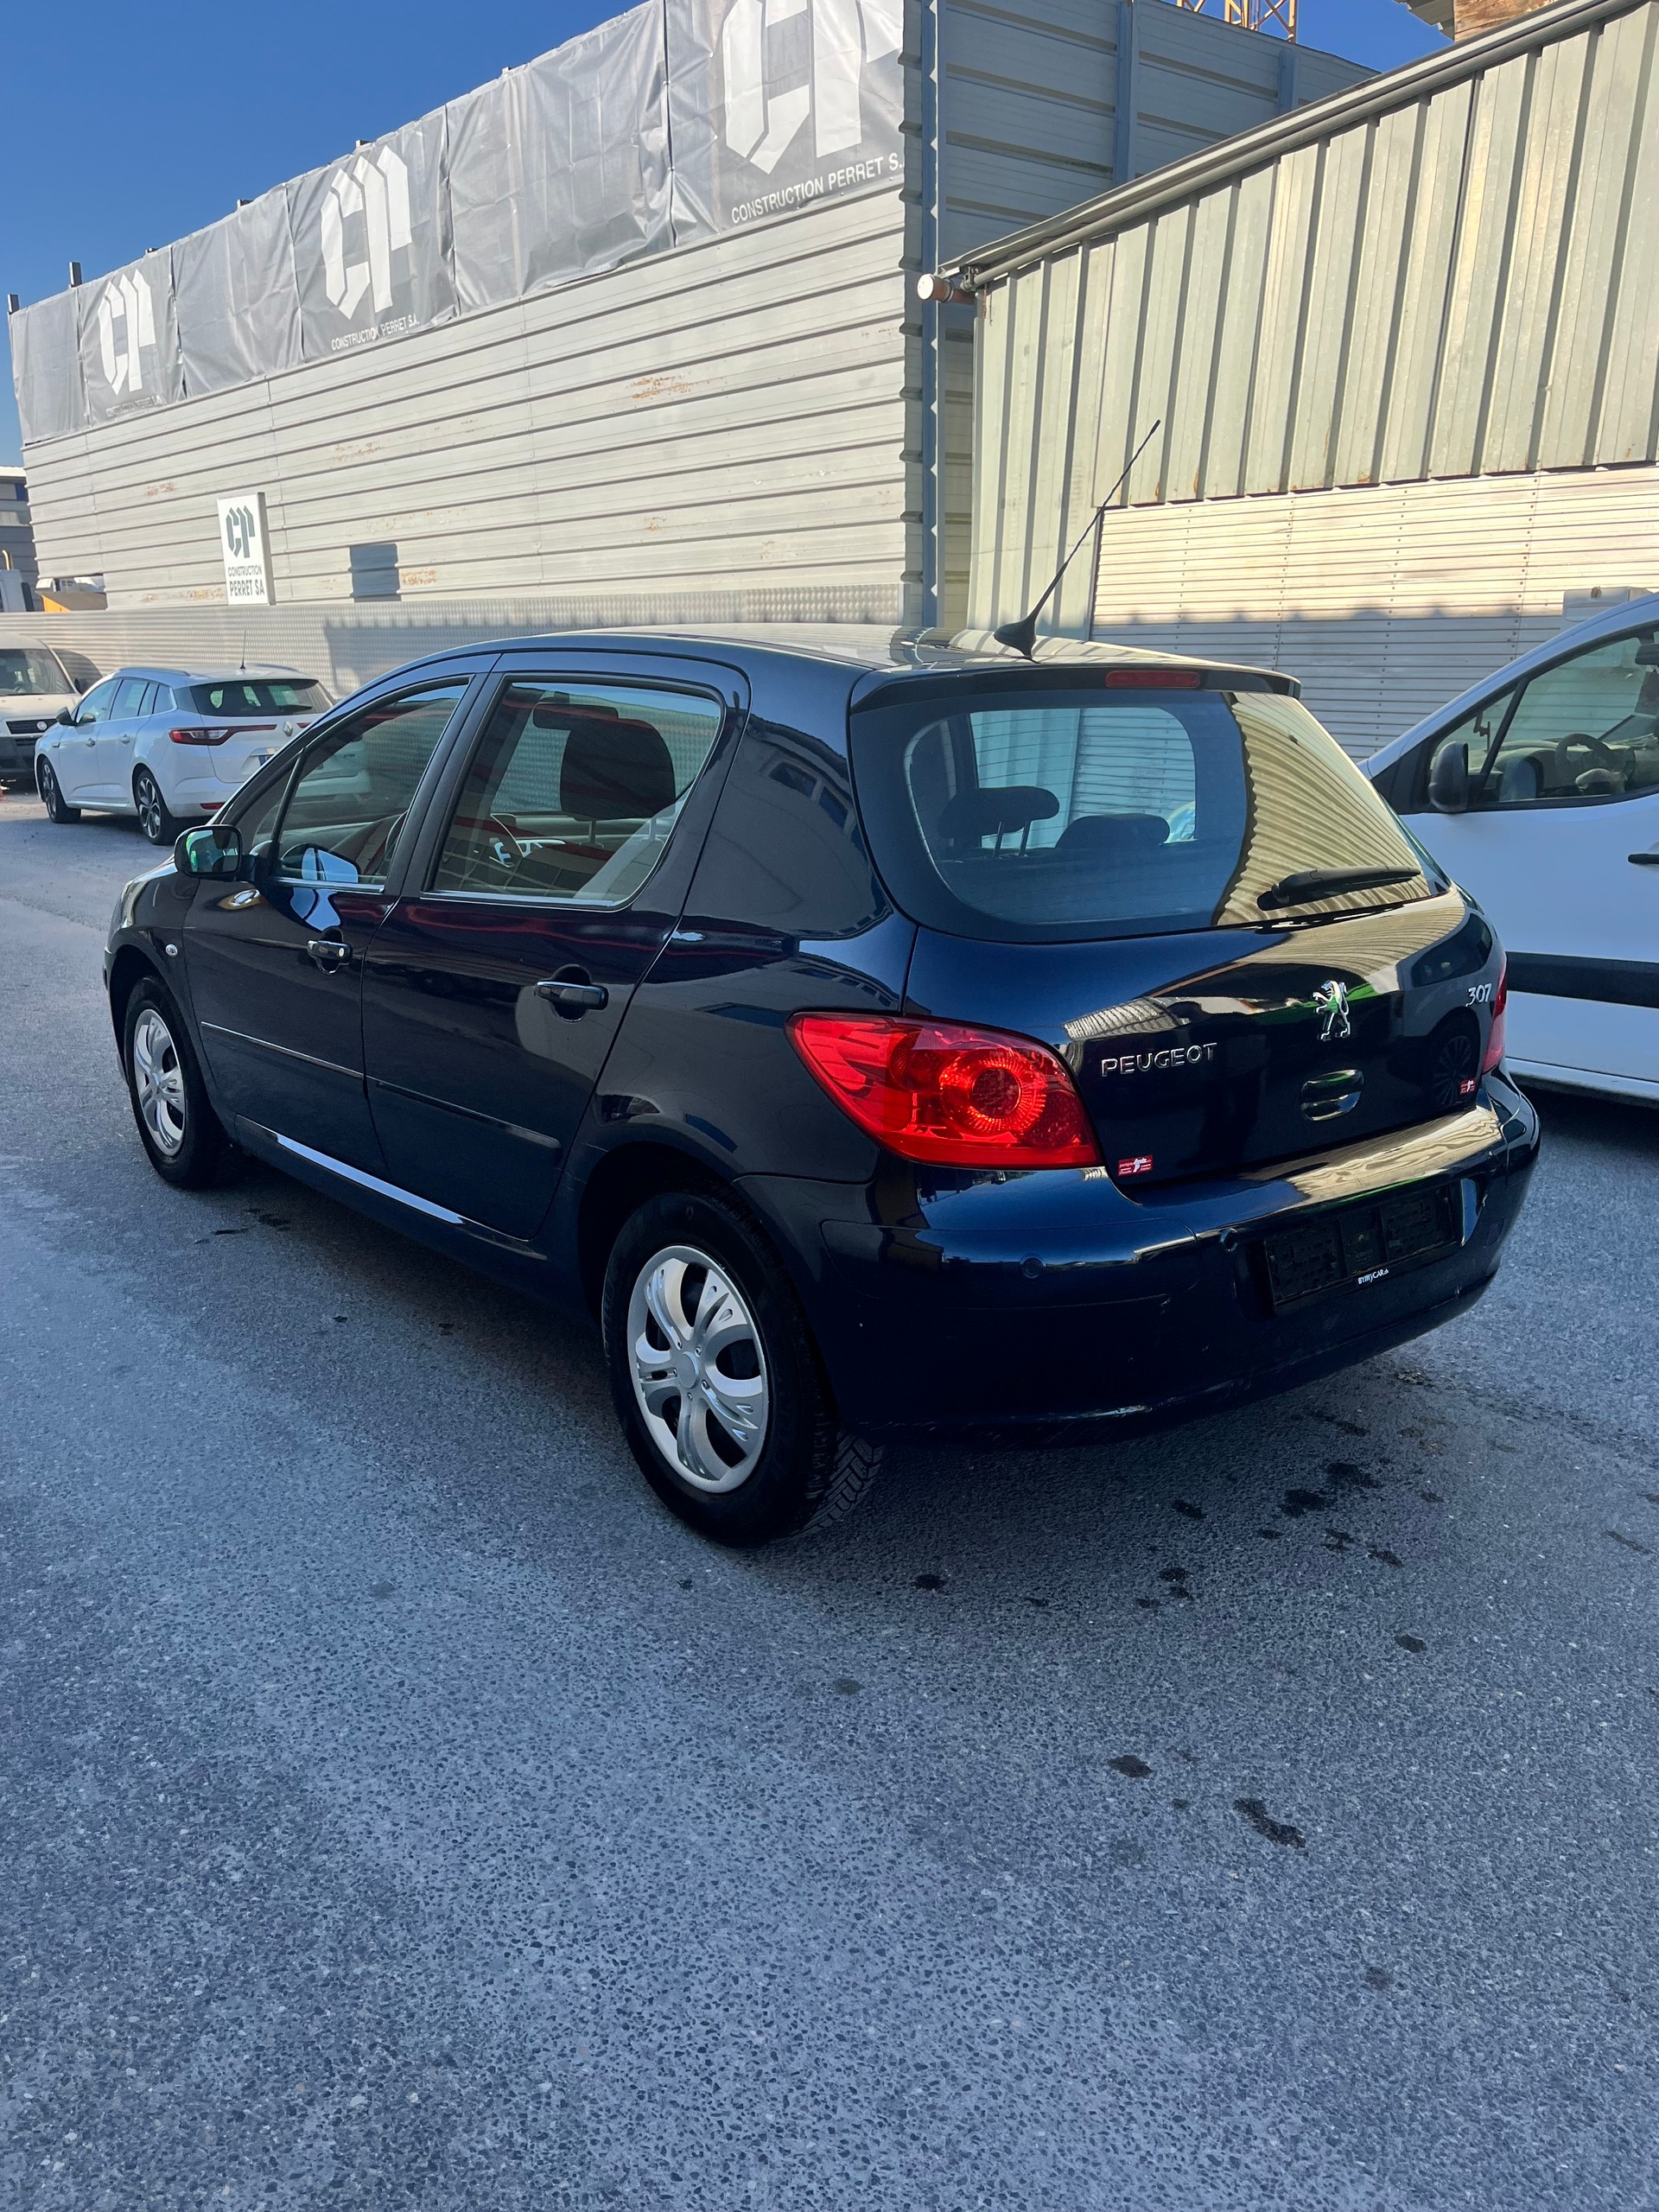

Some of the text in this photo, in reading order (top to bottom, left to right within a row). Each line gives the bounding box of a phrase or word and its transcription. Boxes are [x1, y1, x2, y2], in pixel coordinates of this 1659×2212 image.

[731, 175, 824, 224] CONSTRUCTION
[828, 156, 884, 190] PERRET
[380, 316, 408, 336] PERRET
[227, 564, 263, 577] CONSTRUCTION
[229, 578, 265, 597] PERRET SA
[1465, 982, 1492, 1007] 307
[1101, 1042, 1217, 1077] PEUGEOT
